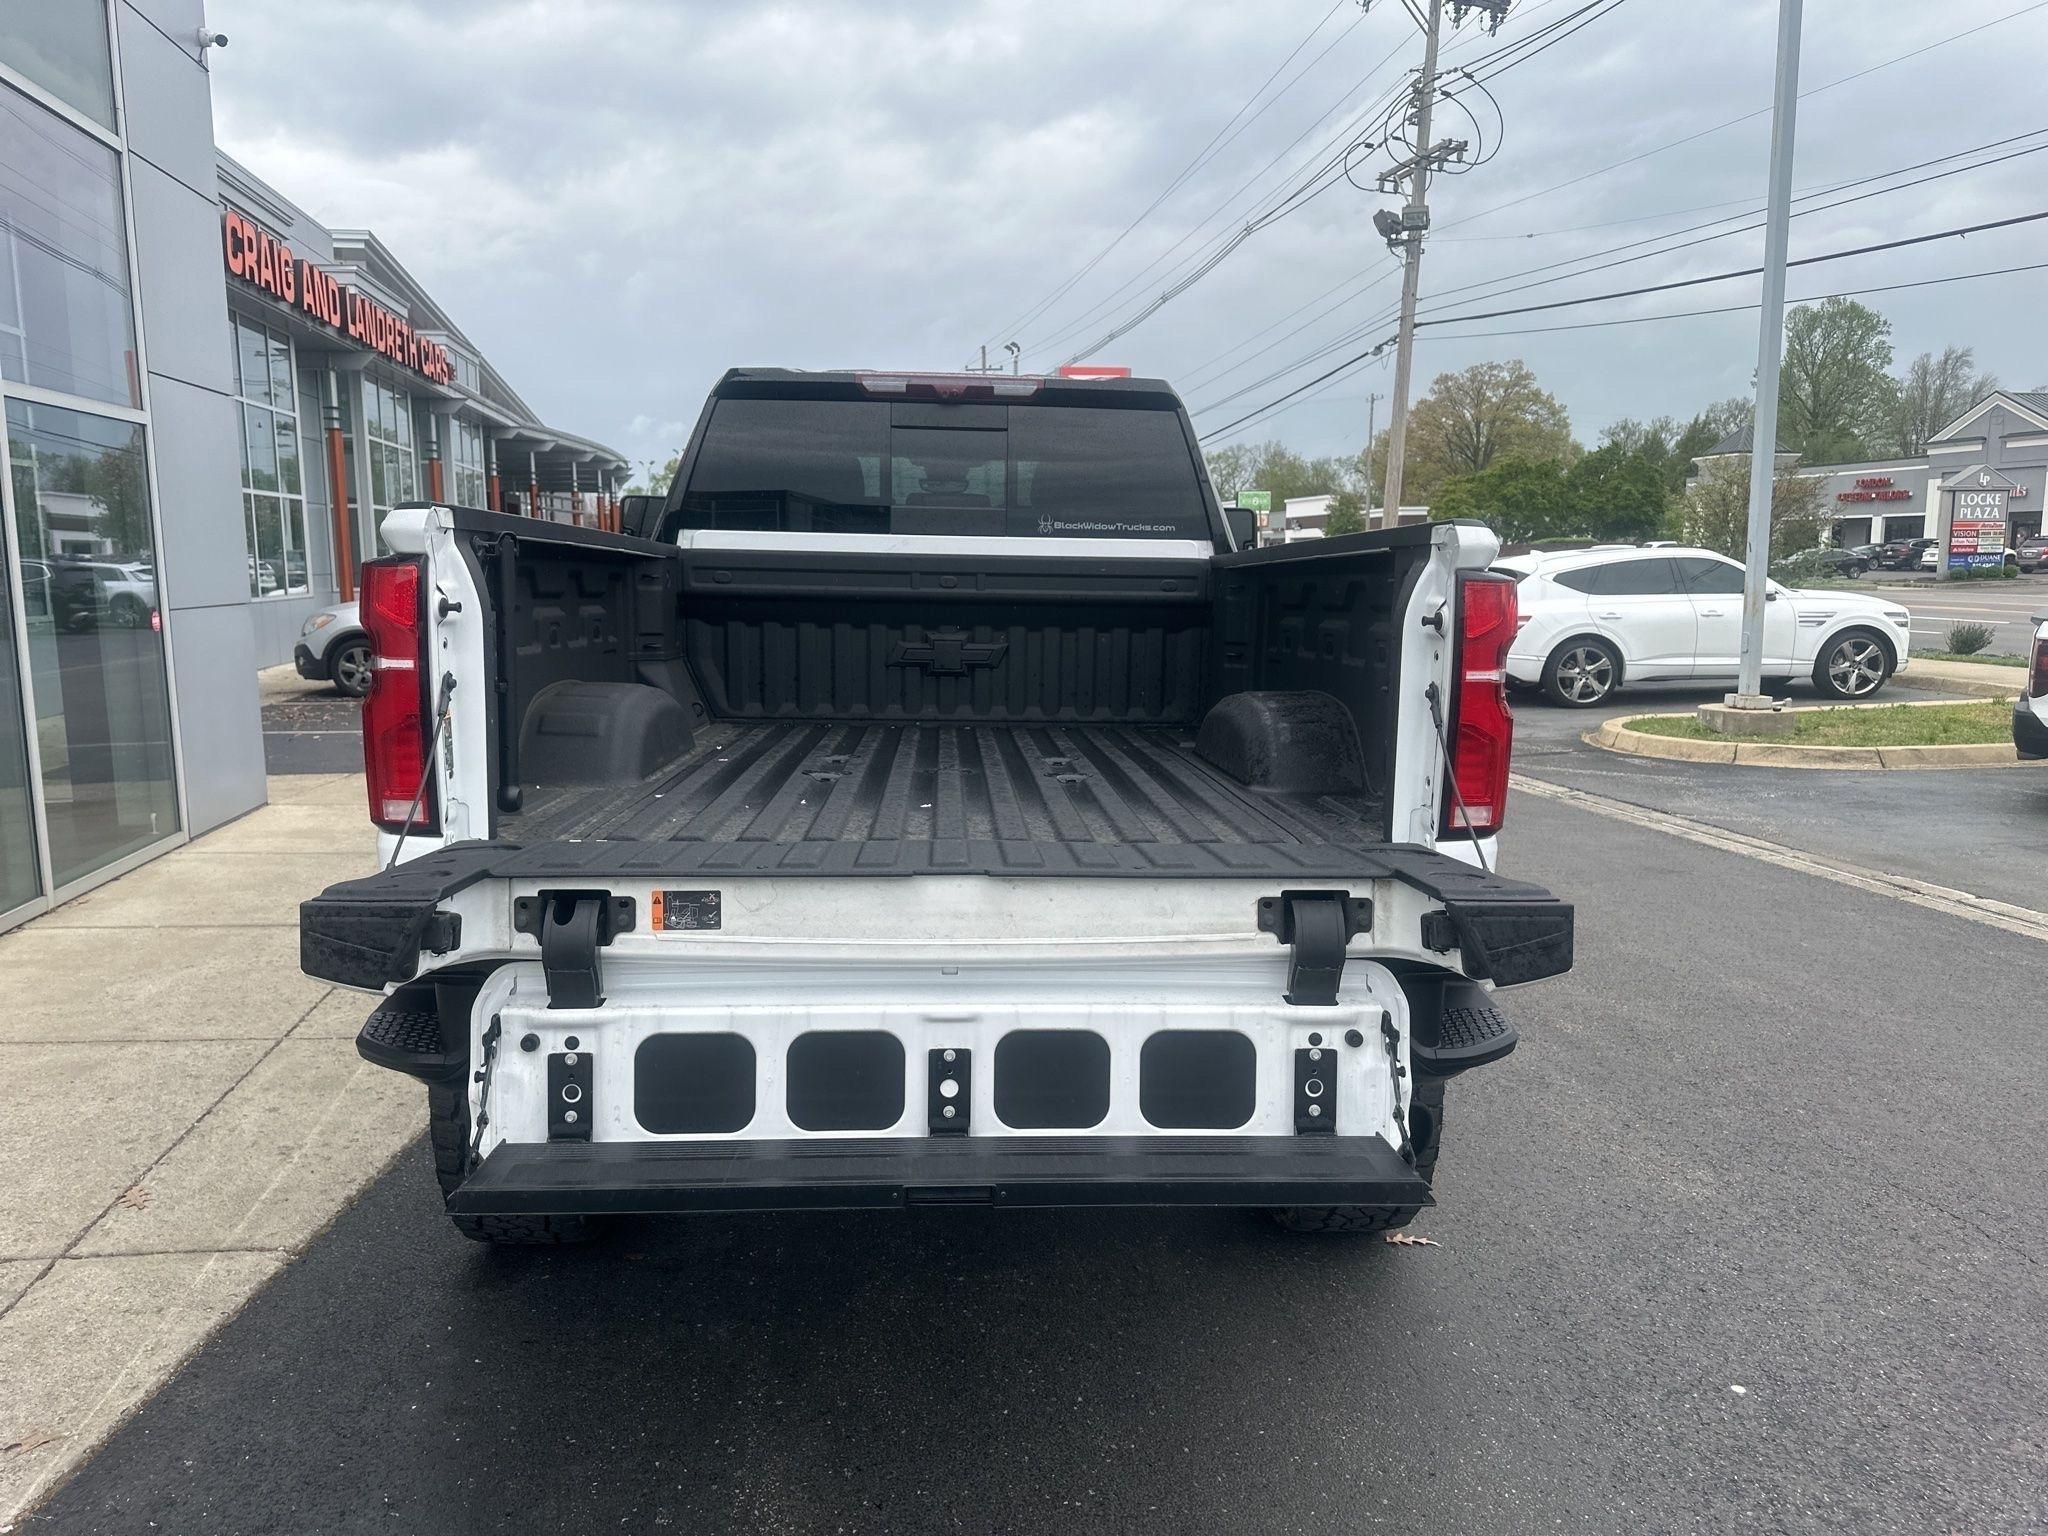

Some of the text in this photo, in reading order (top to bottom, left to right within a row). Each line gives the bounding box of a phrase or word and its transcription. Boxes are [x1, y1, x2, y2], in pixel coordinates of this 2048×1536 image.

[223, 210, 449, 386] CRAIG AND LANDRETH CARS
[1961, 493, 2001, 505] LOCKE
[1960, 507, 2000, 519] PLAZA
[1054, 521, 1176, 532] BlackWidowTrucks.com
